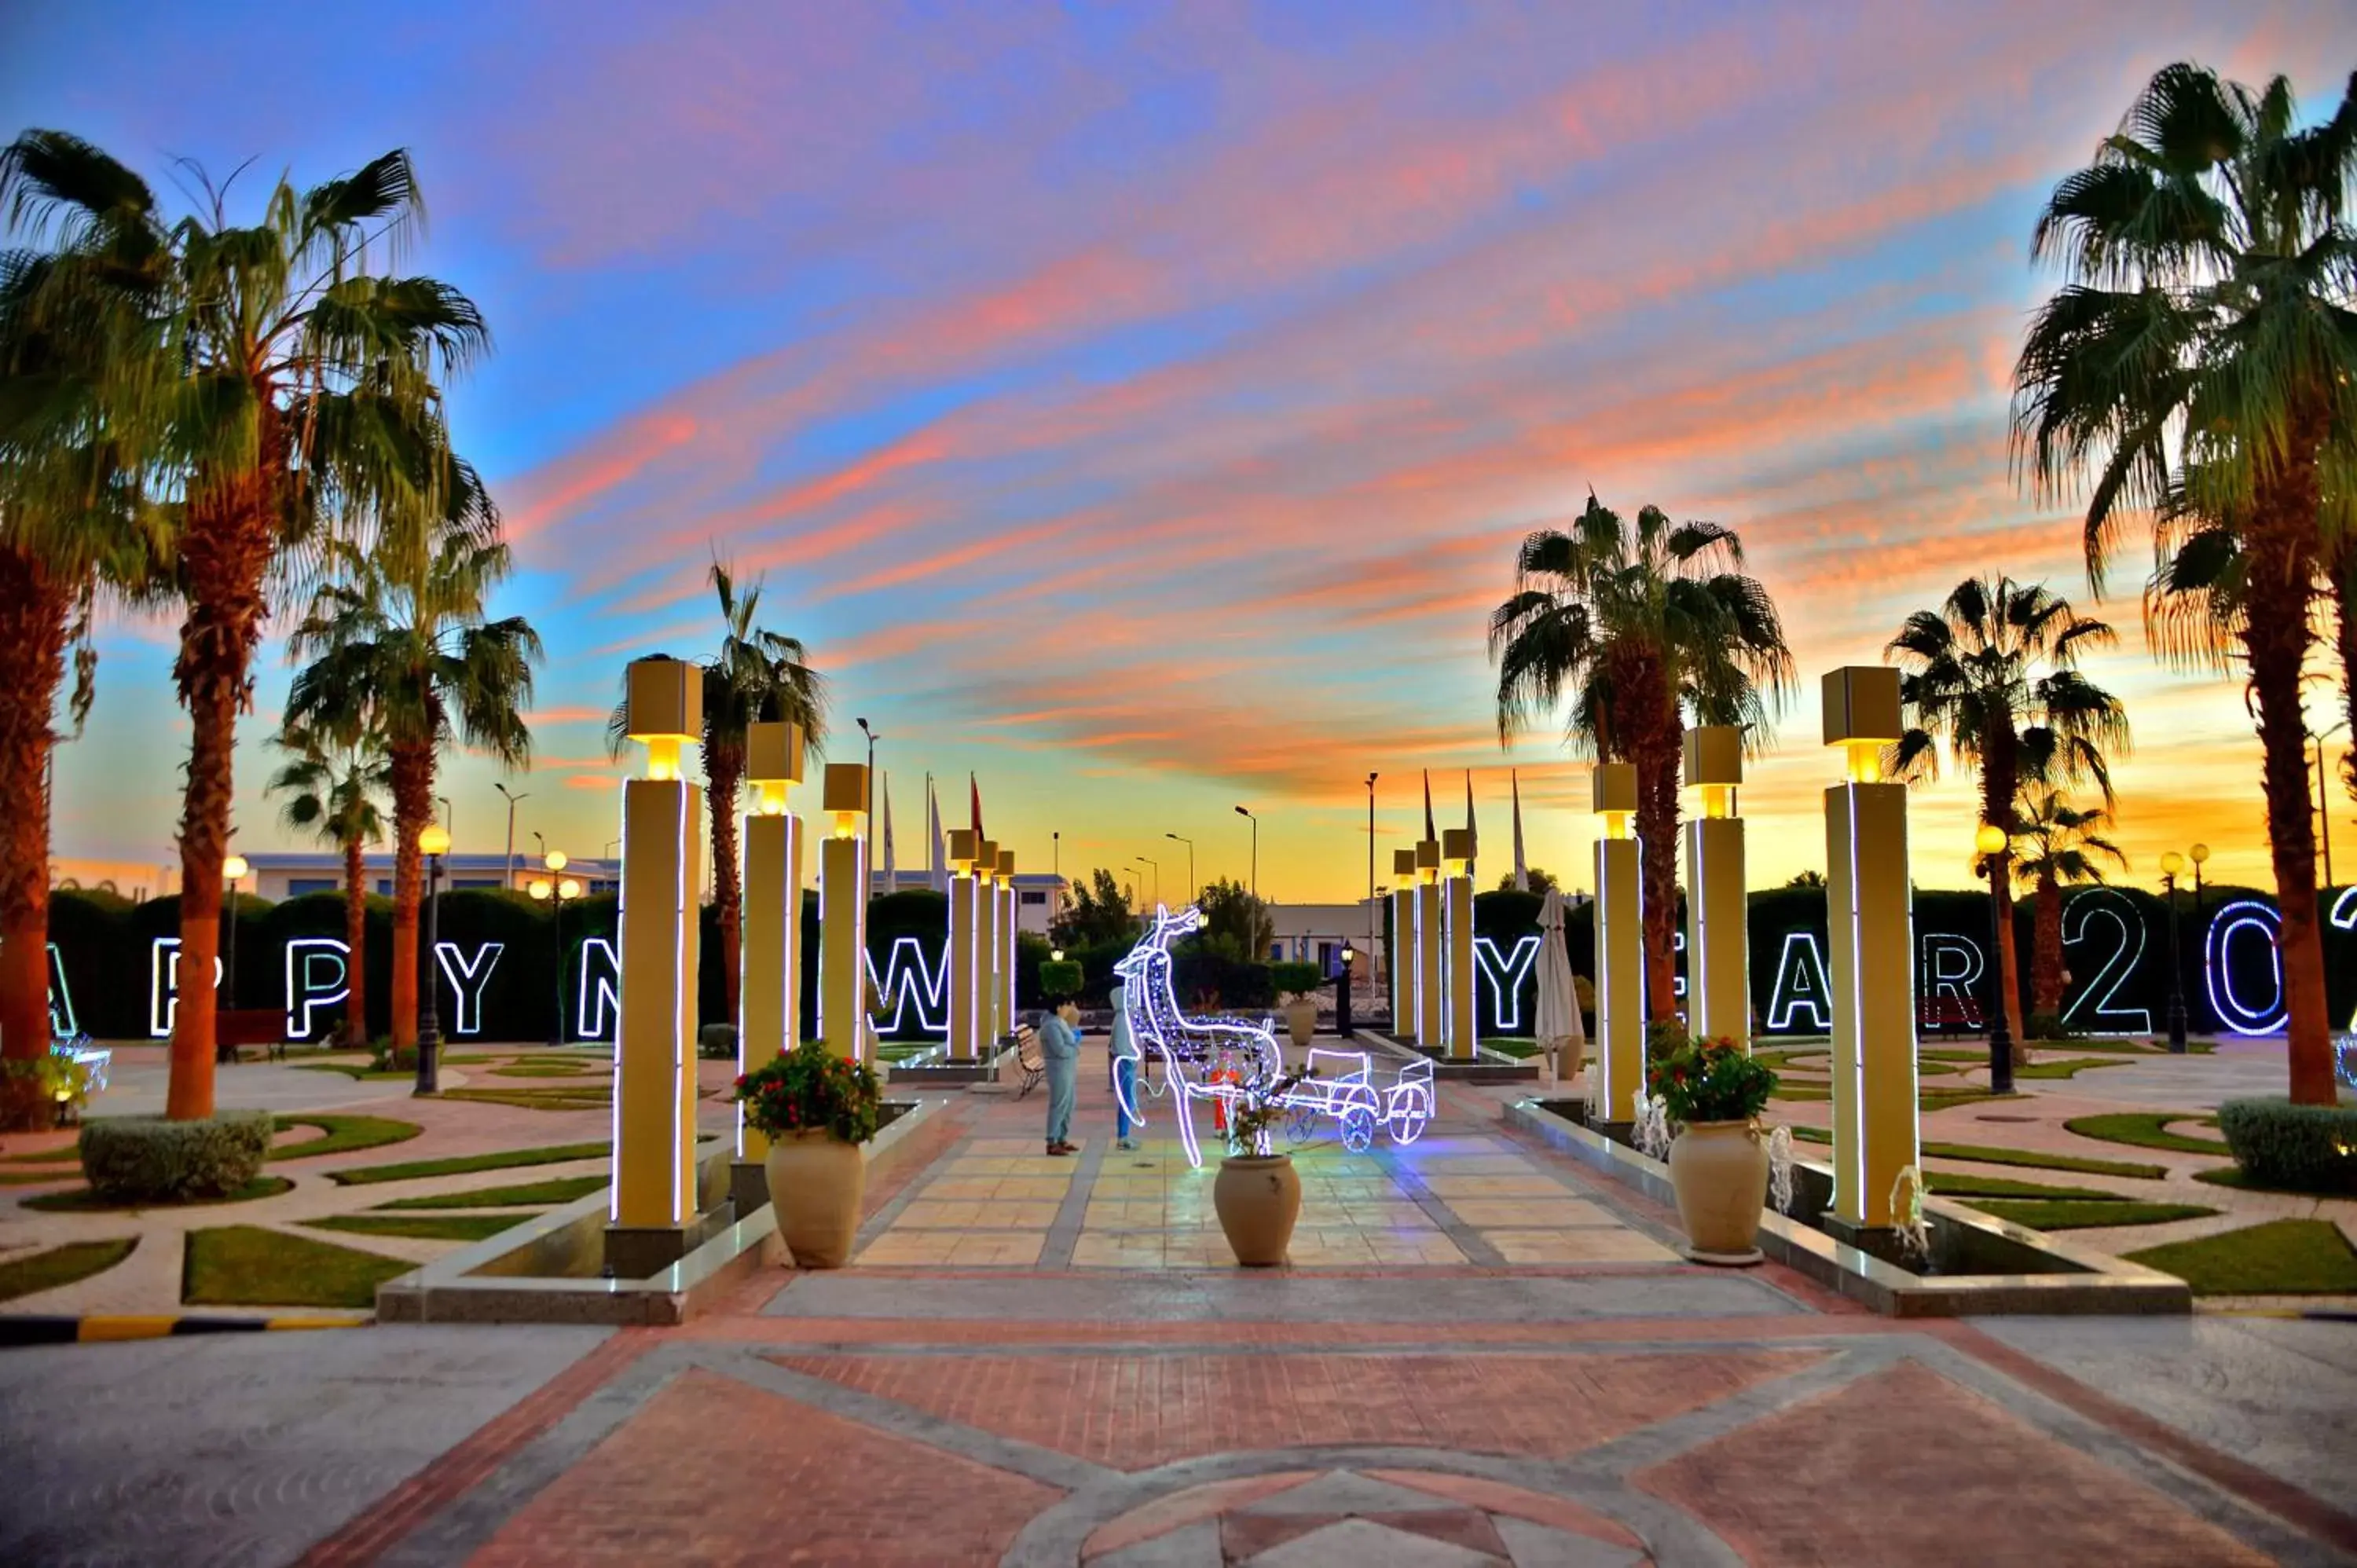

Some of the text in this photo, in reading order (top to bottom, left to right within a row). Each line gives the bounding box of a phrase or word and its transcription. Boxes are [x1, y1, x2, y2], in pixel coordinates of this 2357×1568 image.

[578, 937, 951, 1037] NW
[1474, 932, 1984, 1028] YAR
[2061, 885, 2357, 1036] 20
